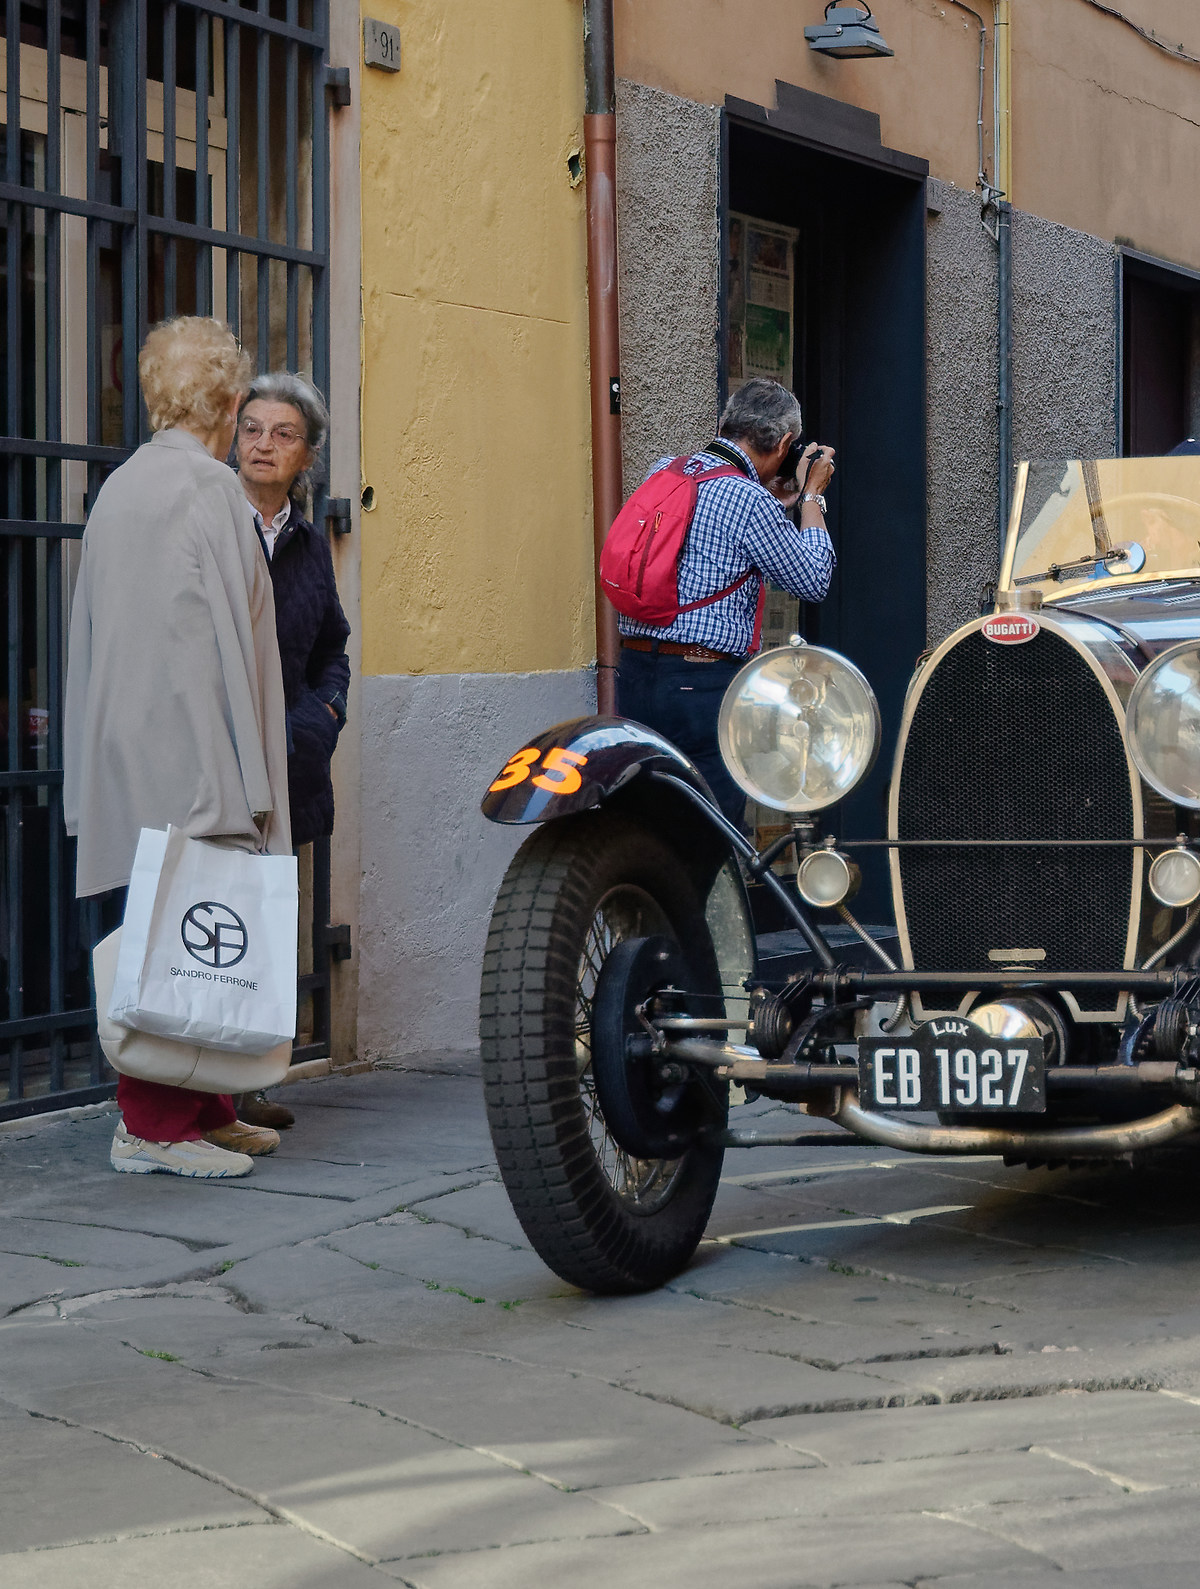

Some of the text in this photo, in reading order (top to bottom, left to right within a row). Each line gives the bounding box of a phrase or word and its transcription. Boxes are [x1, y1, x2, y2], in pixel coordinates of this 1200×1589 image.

[379, 31, 394, 61] 91
[986, 623, 1033, 636] BUGATTI
[488, 747, 589, 795] 35
[170, 967, 258, 991] SANDRO FERRONE
[874, 1048, 1029, 1106] EB 1927
